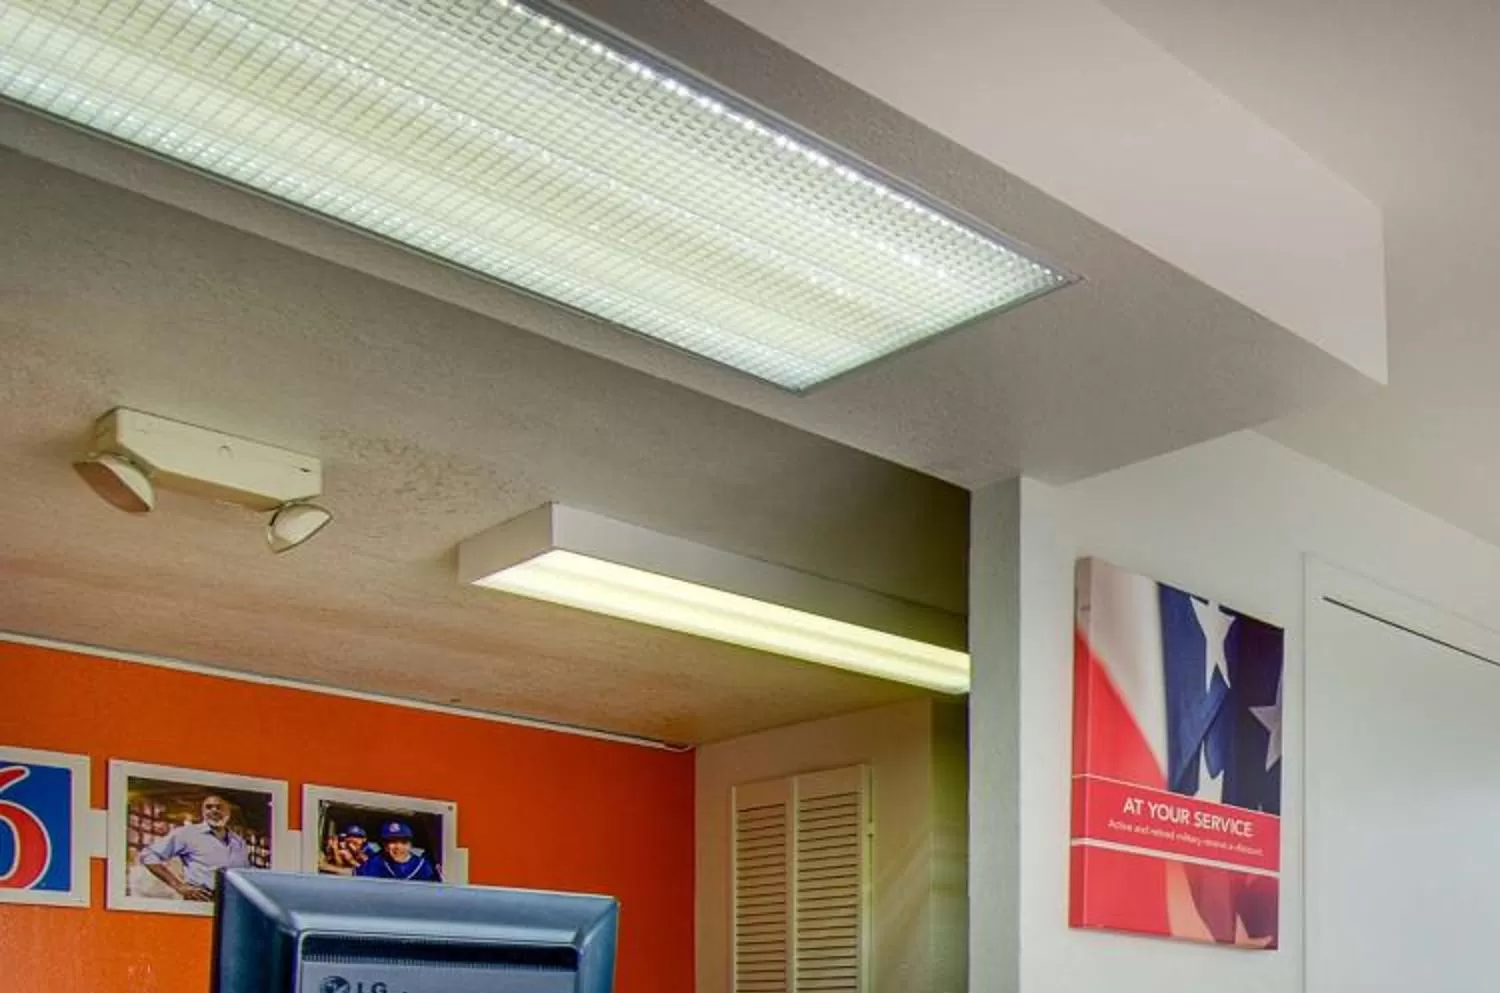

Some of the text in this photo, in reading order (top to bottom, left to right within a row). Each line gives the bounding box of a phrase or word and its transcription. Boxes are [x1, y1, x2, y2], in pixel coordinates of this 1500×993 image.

[1123, 797, 1255, 838] AT YOUR SERVICE
